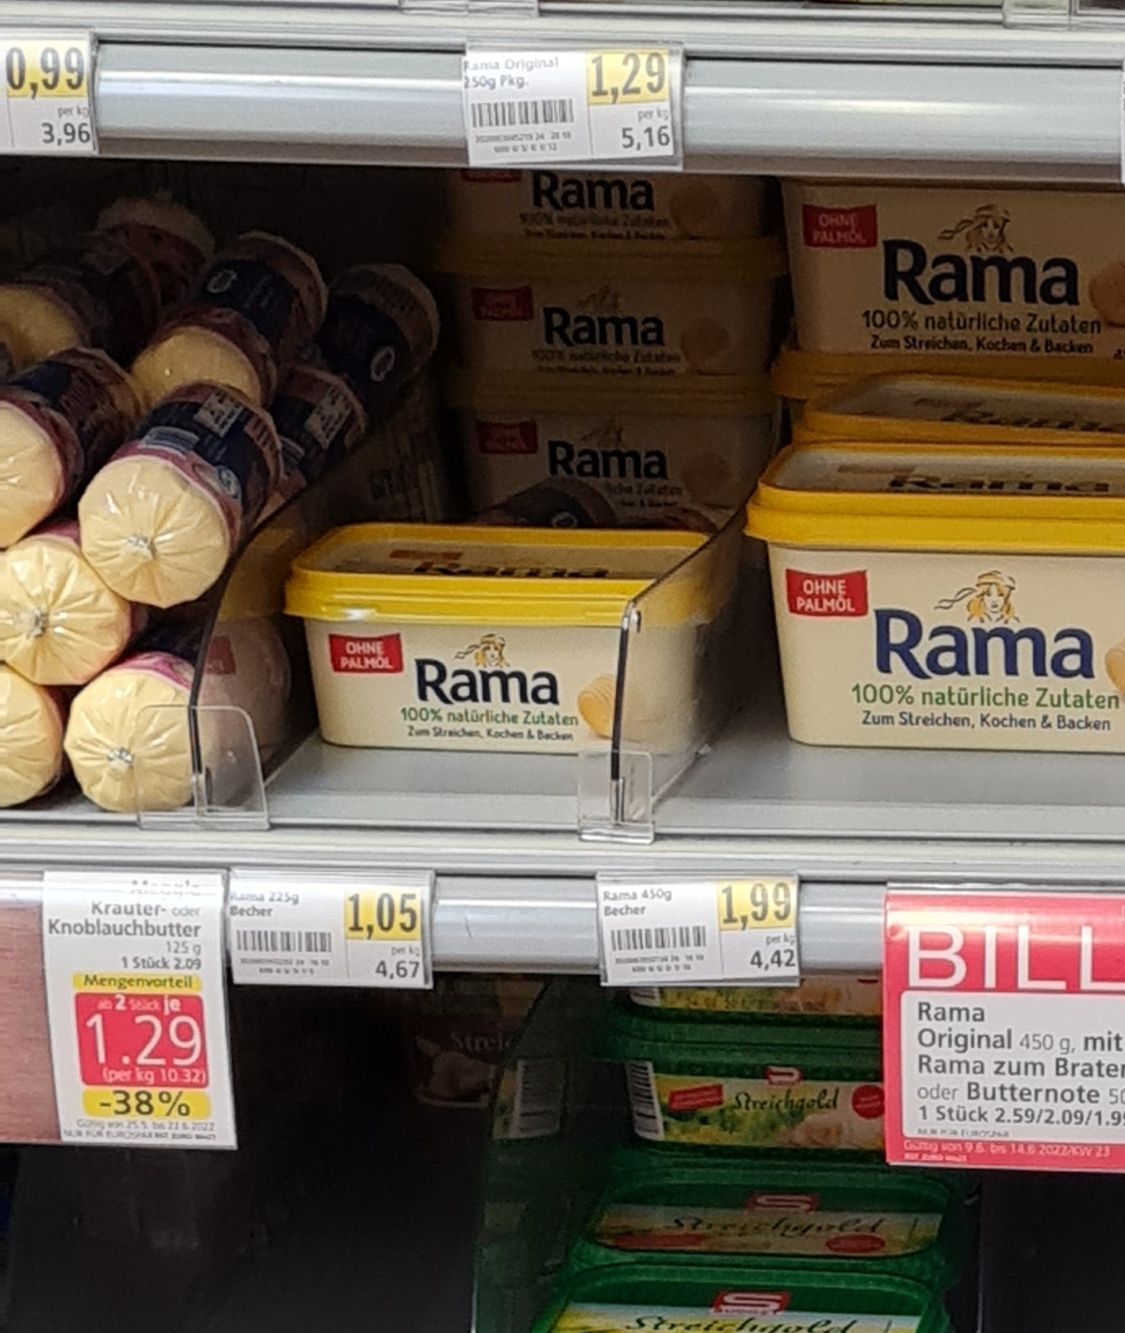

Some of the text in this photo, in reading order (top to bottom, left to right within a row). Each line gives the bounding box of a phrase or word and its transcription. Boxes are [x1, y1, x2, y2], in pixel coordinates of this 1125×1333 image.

[6, 46, 84, 100] 0,99
[590, 51, 667, 104] 1,29
[41, 122, 91, 146] 3,96
[622, 125, 671, 152] 5,16
[531, 174, 654, 212] Rama
[882, 241, 1081, 307] Rama
[542, 307, 665, 346] Rama
[548, 441, 668, 479] Rama
[801, 576, 849, 595] OHNE
[795, 591, 858, 614] PALMÖL
[345, 642, 385, 654] OHNE
[874, 608, 1095, 681] Rama
[339, 652, 395, 672] PALMÖL
[415, 658, 560, 705] Rama
[850, 684, 1121, 711] 100% natürliche Zutaten
[400, 706, 580, 727] 100% natürliche Zutaten
[861, 709, 1111, 731] Zum Streichen, Kochen & Backen
[603, 888, 673, 902] Rama 450g
[721, 882, 791, 930] 1,99
[347, 893, 417, 940] 1,05
[604, 904, 647, 916] Becher
[48, 919, 202, 939] Knoblauchbutter
[166, 942, 201, 956] 125 g
[749, 950, 797, 969] 4,42
[132, 955, 169, 968] Stück
[174, 957, 202, 970] 2.09
[375, 961, 420, 978] 4,67
[83, 973, 193, 991] Mengenvorteil
[918, 1002, 985, 1023] Rama
[85, 1015, 202, 1066] 1.29
[918, 1028, 1012, 1054] Original
[1019, 1033, 1054, 1052] 450
[1058, 1037, 1075, 1055] g,
[1084, 1033, 1123, 1054] mit
[918, 1055, 985, 1076] Rama
[993, 1060, 1046, 1077] zum
[99, 1090, 191, 1117] -38%
[734, 1089, 838, 1112] Streichgold
[918, 1083, 958, 1100] oder
[966, 1083, 1100, 1104] Butternote
[919, 1106, 928, 1120] 1
[935, 1105, 989, 1122] Stück
